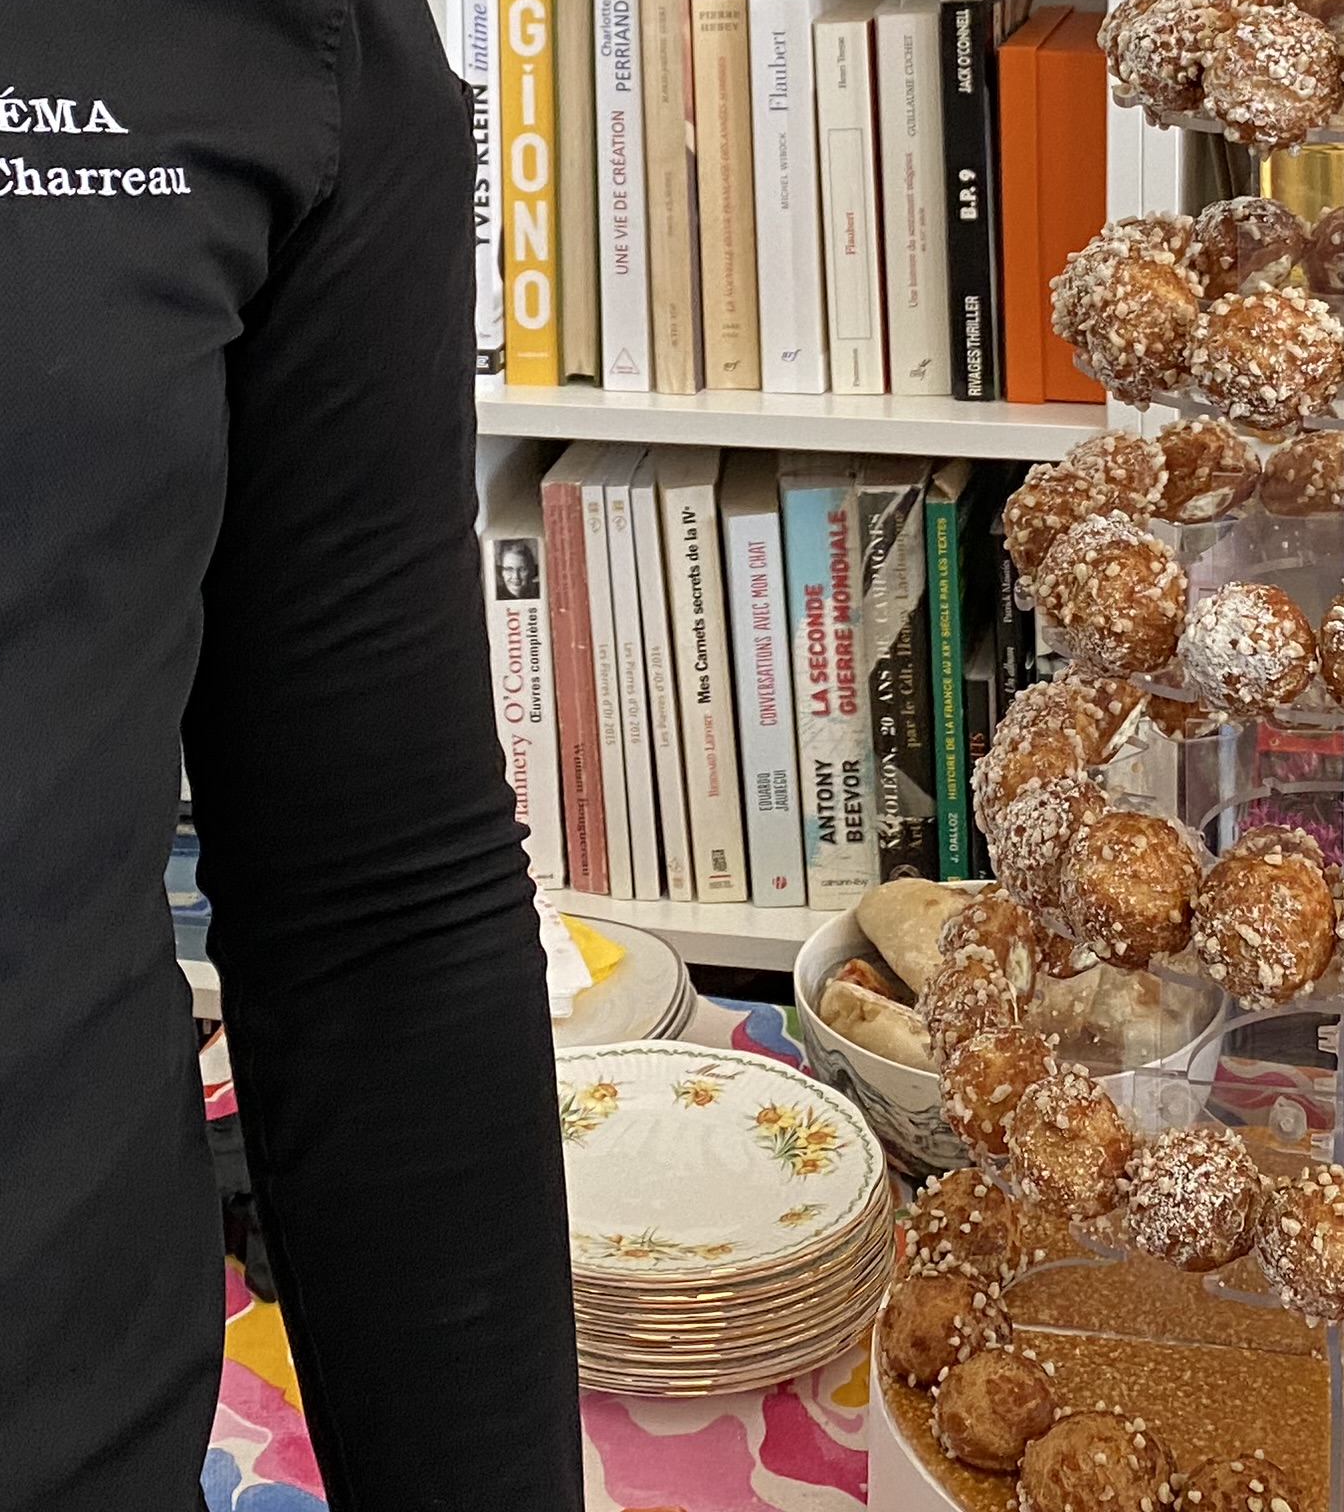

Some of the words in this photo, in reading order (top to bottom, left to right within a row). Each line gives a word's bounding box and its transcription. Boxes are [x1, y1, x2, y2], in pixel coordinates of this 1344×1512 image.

[466, 3, 490, 73] intime
[600, 0, 613, 57] Charlotte
[612, 0, 633, 92] PERRIAND
[955, 8, 972, 66] O'CONNELL
[768, 30, 790, 113] Flaubert
[957, 67, 973, 93] JACK
[471, 83, 490, 166] KLEIN
[905, 78, 918, 137] GUILLAUME
[608, 109, 627, 186] CRÉATION
[778, 131, 789, 171] WINOCK
[779, 174, 790, 210] MICHEL
[958, 167, 976, 182] 9
[474, 177, 493, 247] YVES
[612, 191, 628, 209] DE
[960, 185, 978, 221] B.P.
[613, 216, 629, 241] VIE
[844, 211, 857, 256] Flaubert
[906, 238, 917, 252] du
[614, 244, 630, 276] UNE
[906, 253, 918, 288] histoire
[907, 289, 919, 309] Une
[964, 295, 983, 397] RIVAGES/THRILLER
[683, 528, 698, 542] la
[685, 543, 699, 562] de
[936, 517, 949, 555] TEXTES
[747, 539, 767, 570] CHAT
[827, 509, 852, 624] MONDIALE
[937, 556, 949, 577] LES
[687, 564, 704, 615] secrets
[749, 573, 769, 598] MON
[751, 602, 771, 631] AVEC
[804, 583, 830, 684] SECONDE
[526, 606, 543, 673] complètes
[598, 643, 610, 661] Les
[623, 641, 634, 660] Les
[691, 618, 710, 672] Carnets
[502, 607, 526, 725] O'Connor
[599, 662, 613, 697] Pierres
[624, 660, 637, 696] Pierres
[652, 670, 665, 692] d'Or
[754, 635, 778, 727] CONVERSATIONS
[833, 627, 859, 717] GUERRE
[941, 659, 954, 675] AU
[528, 675, 543, 724] Œuvres
[697, 674, 713, 705] Mes
[810, 688, 832, 717] LA
[877, 669, 894, 705] ANS
[941, 677, 954, 719] FRANCE
[602, 699, 615, 720] d'Or
[626, 697, 639, 719] d'Or
[655, 693, 669, 730] Pierres
[901, 700, 916, 716] le
[604, 722, 616, 746] 2015
[628, 720, 641, 745] 2016
[658, 731, 670, 749] Les
[702, 714, 716, 752] LEFORT
[879, 716, 896, 737] 20
[904, 720, 922, 749] par
[942, 720, 955, 735] LA
[943, 736, 956, 751] DE
[756, 771, 774, 812] EDUARDO
[943, 752, 957, 801] HISTOIRE
[814, 758, 838, 845] ANTONY
[840, 758, 865, 844] BEEVOR
[947, 811, 959, 852] DALLOZ
